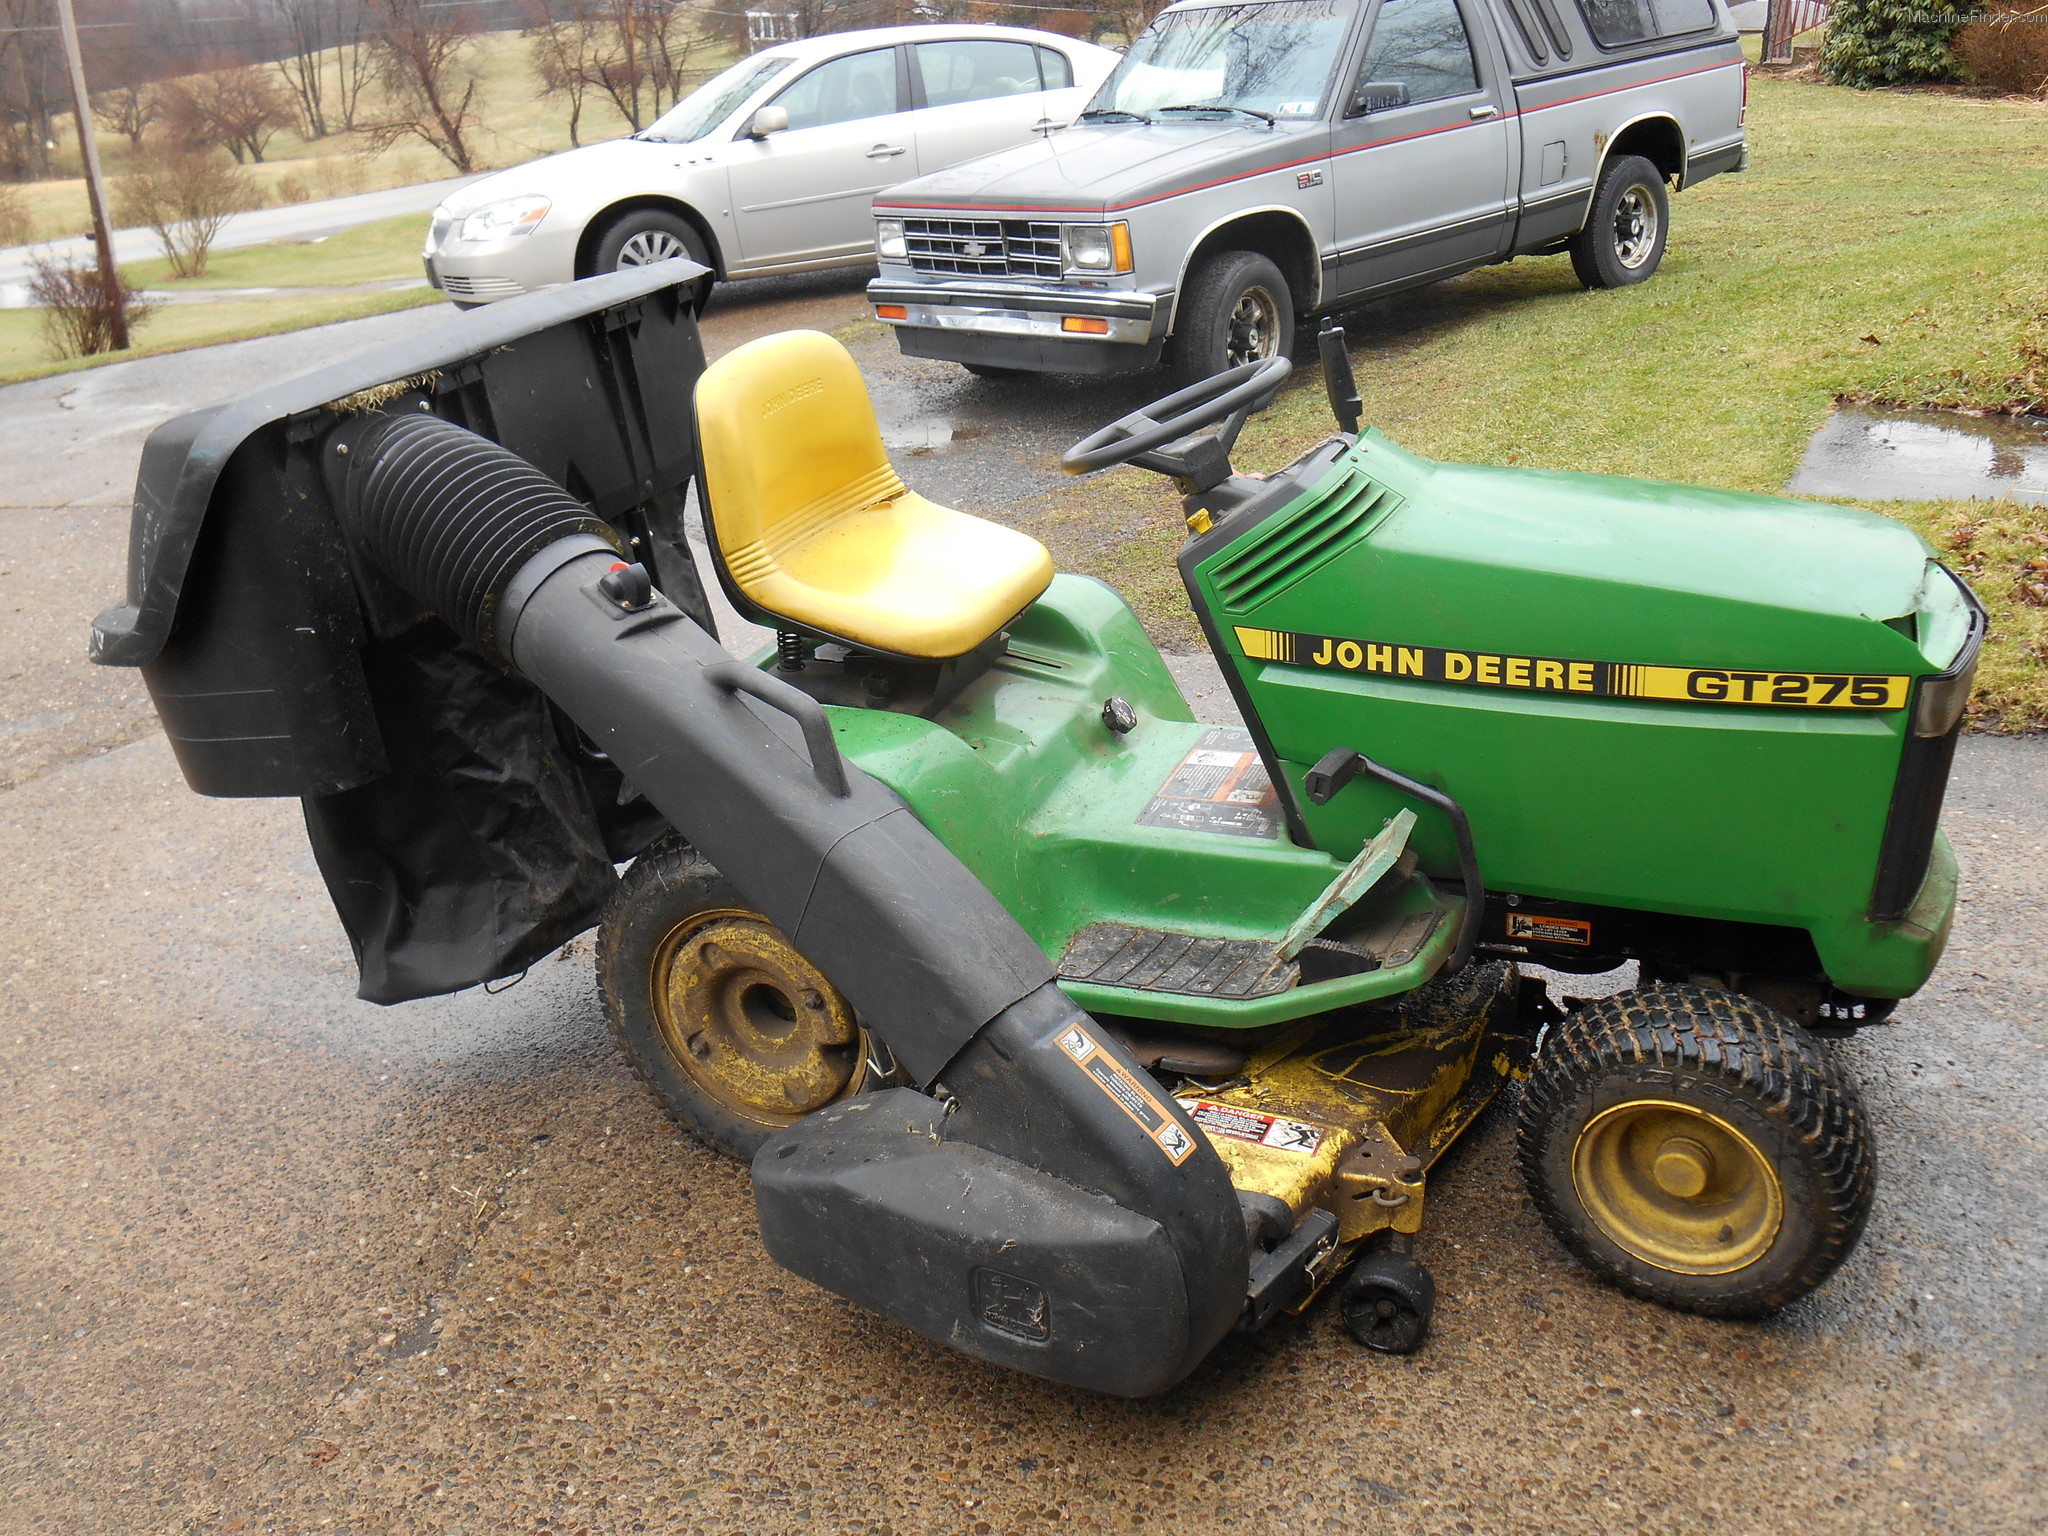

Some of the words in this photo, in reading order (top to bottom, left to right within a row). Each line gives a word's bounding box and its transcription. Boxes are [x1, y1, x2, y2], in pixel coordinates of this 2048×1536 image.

[1312, 638, 1424, 677] JOHN
[1443, 651, 1595, 692] DEERE
[1686, 671, 1890, 704] GT275
[1120, 1070, 1152, 1103] WARNING
[1220, 1107, 1264, 1120] DANGER
